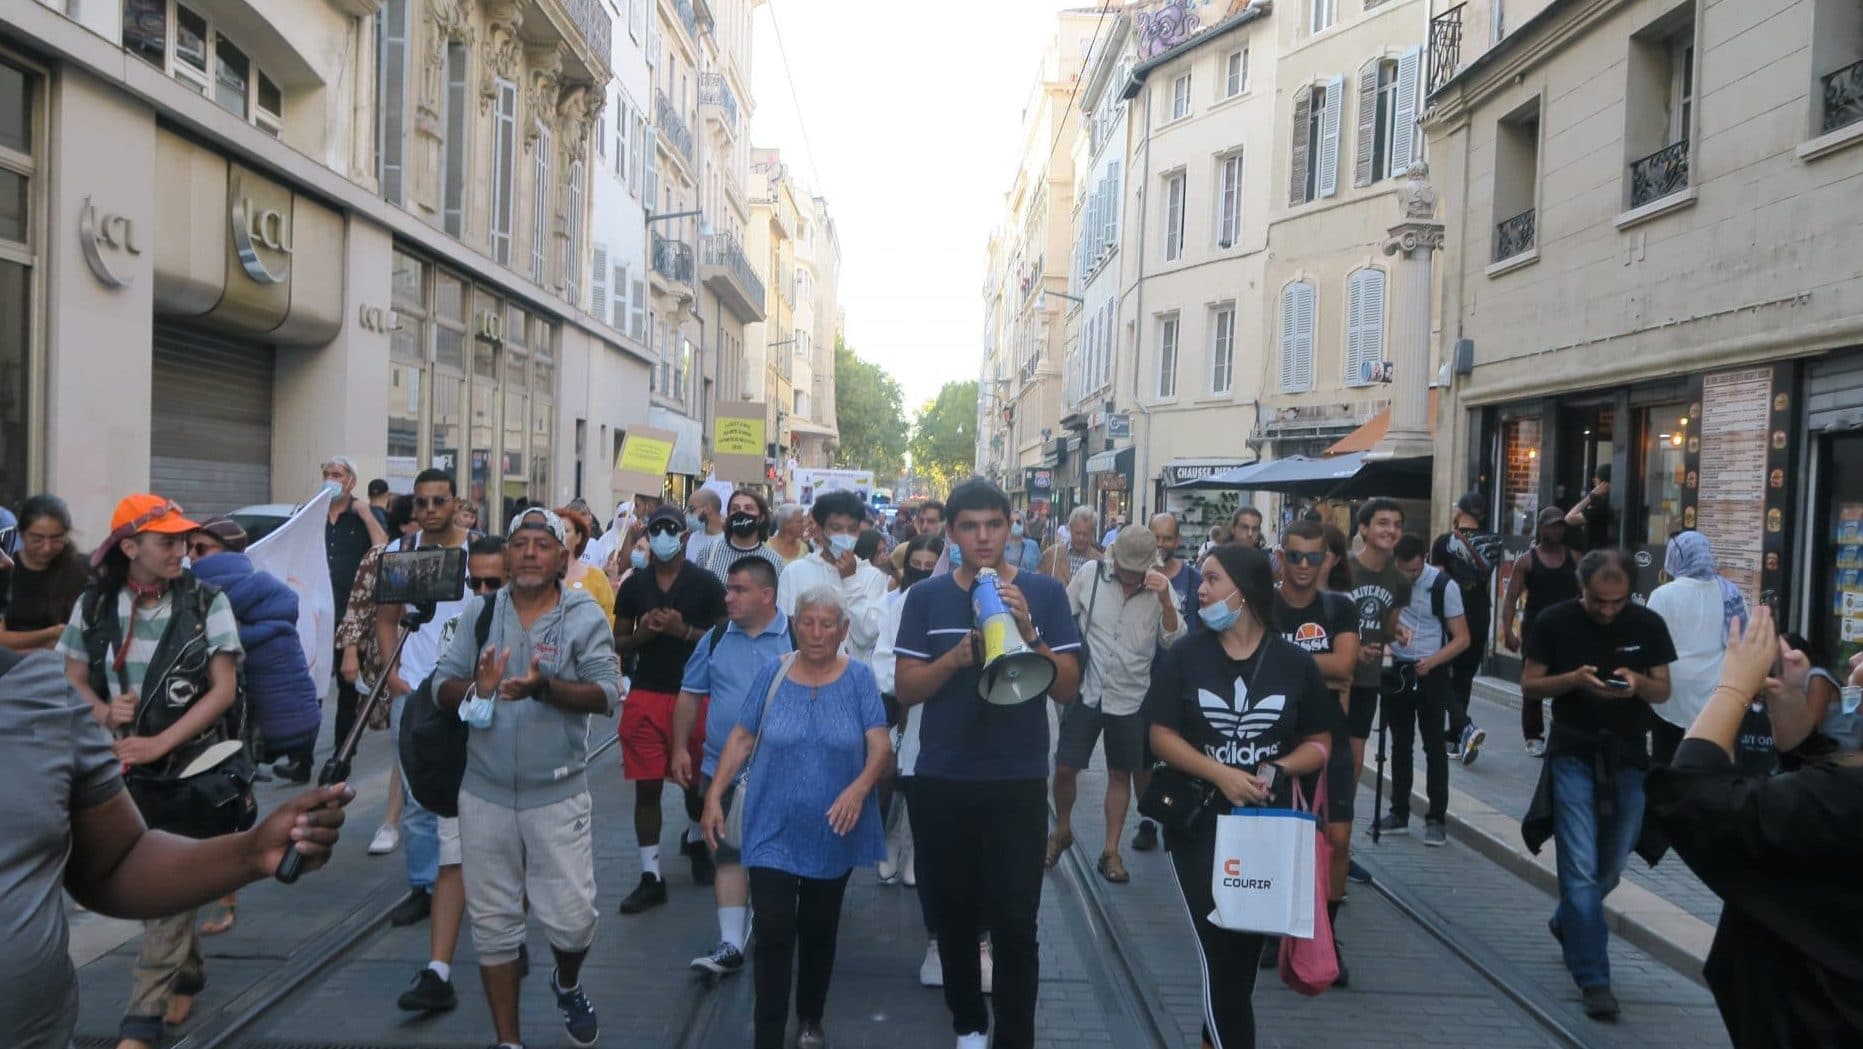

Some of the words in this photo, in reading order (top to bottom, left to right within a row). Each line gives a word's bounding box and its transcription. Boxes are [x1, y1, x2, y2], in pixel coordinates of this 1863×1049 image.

[245, 198, 293, 254] LCL
[1177, 467, 1212, 479] CHAUSSE
[1351, 584, 1393, 607] NIVERSITY
[1281, 632, 1330, 651] llsse
[1223, 877, 1272, 889] COURIR
